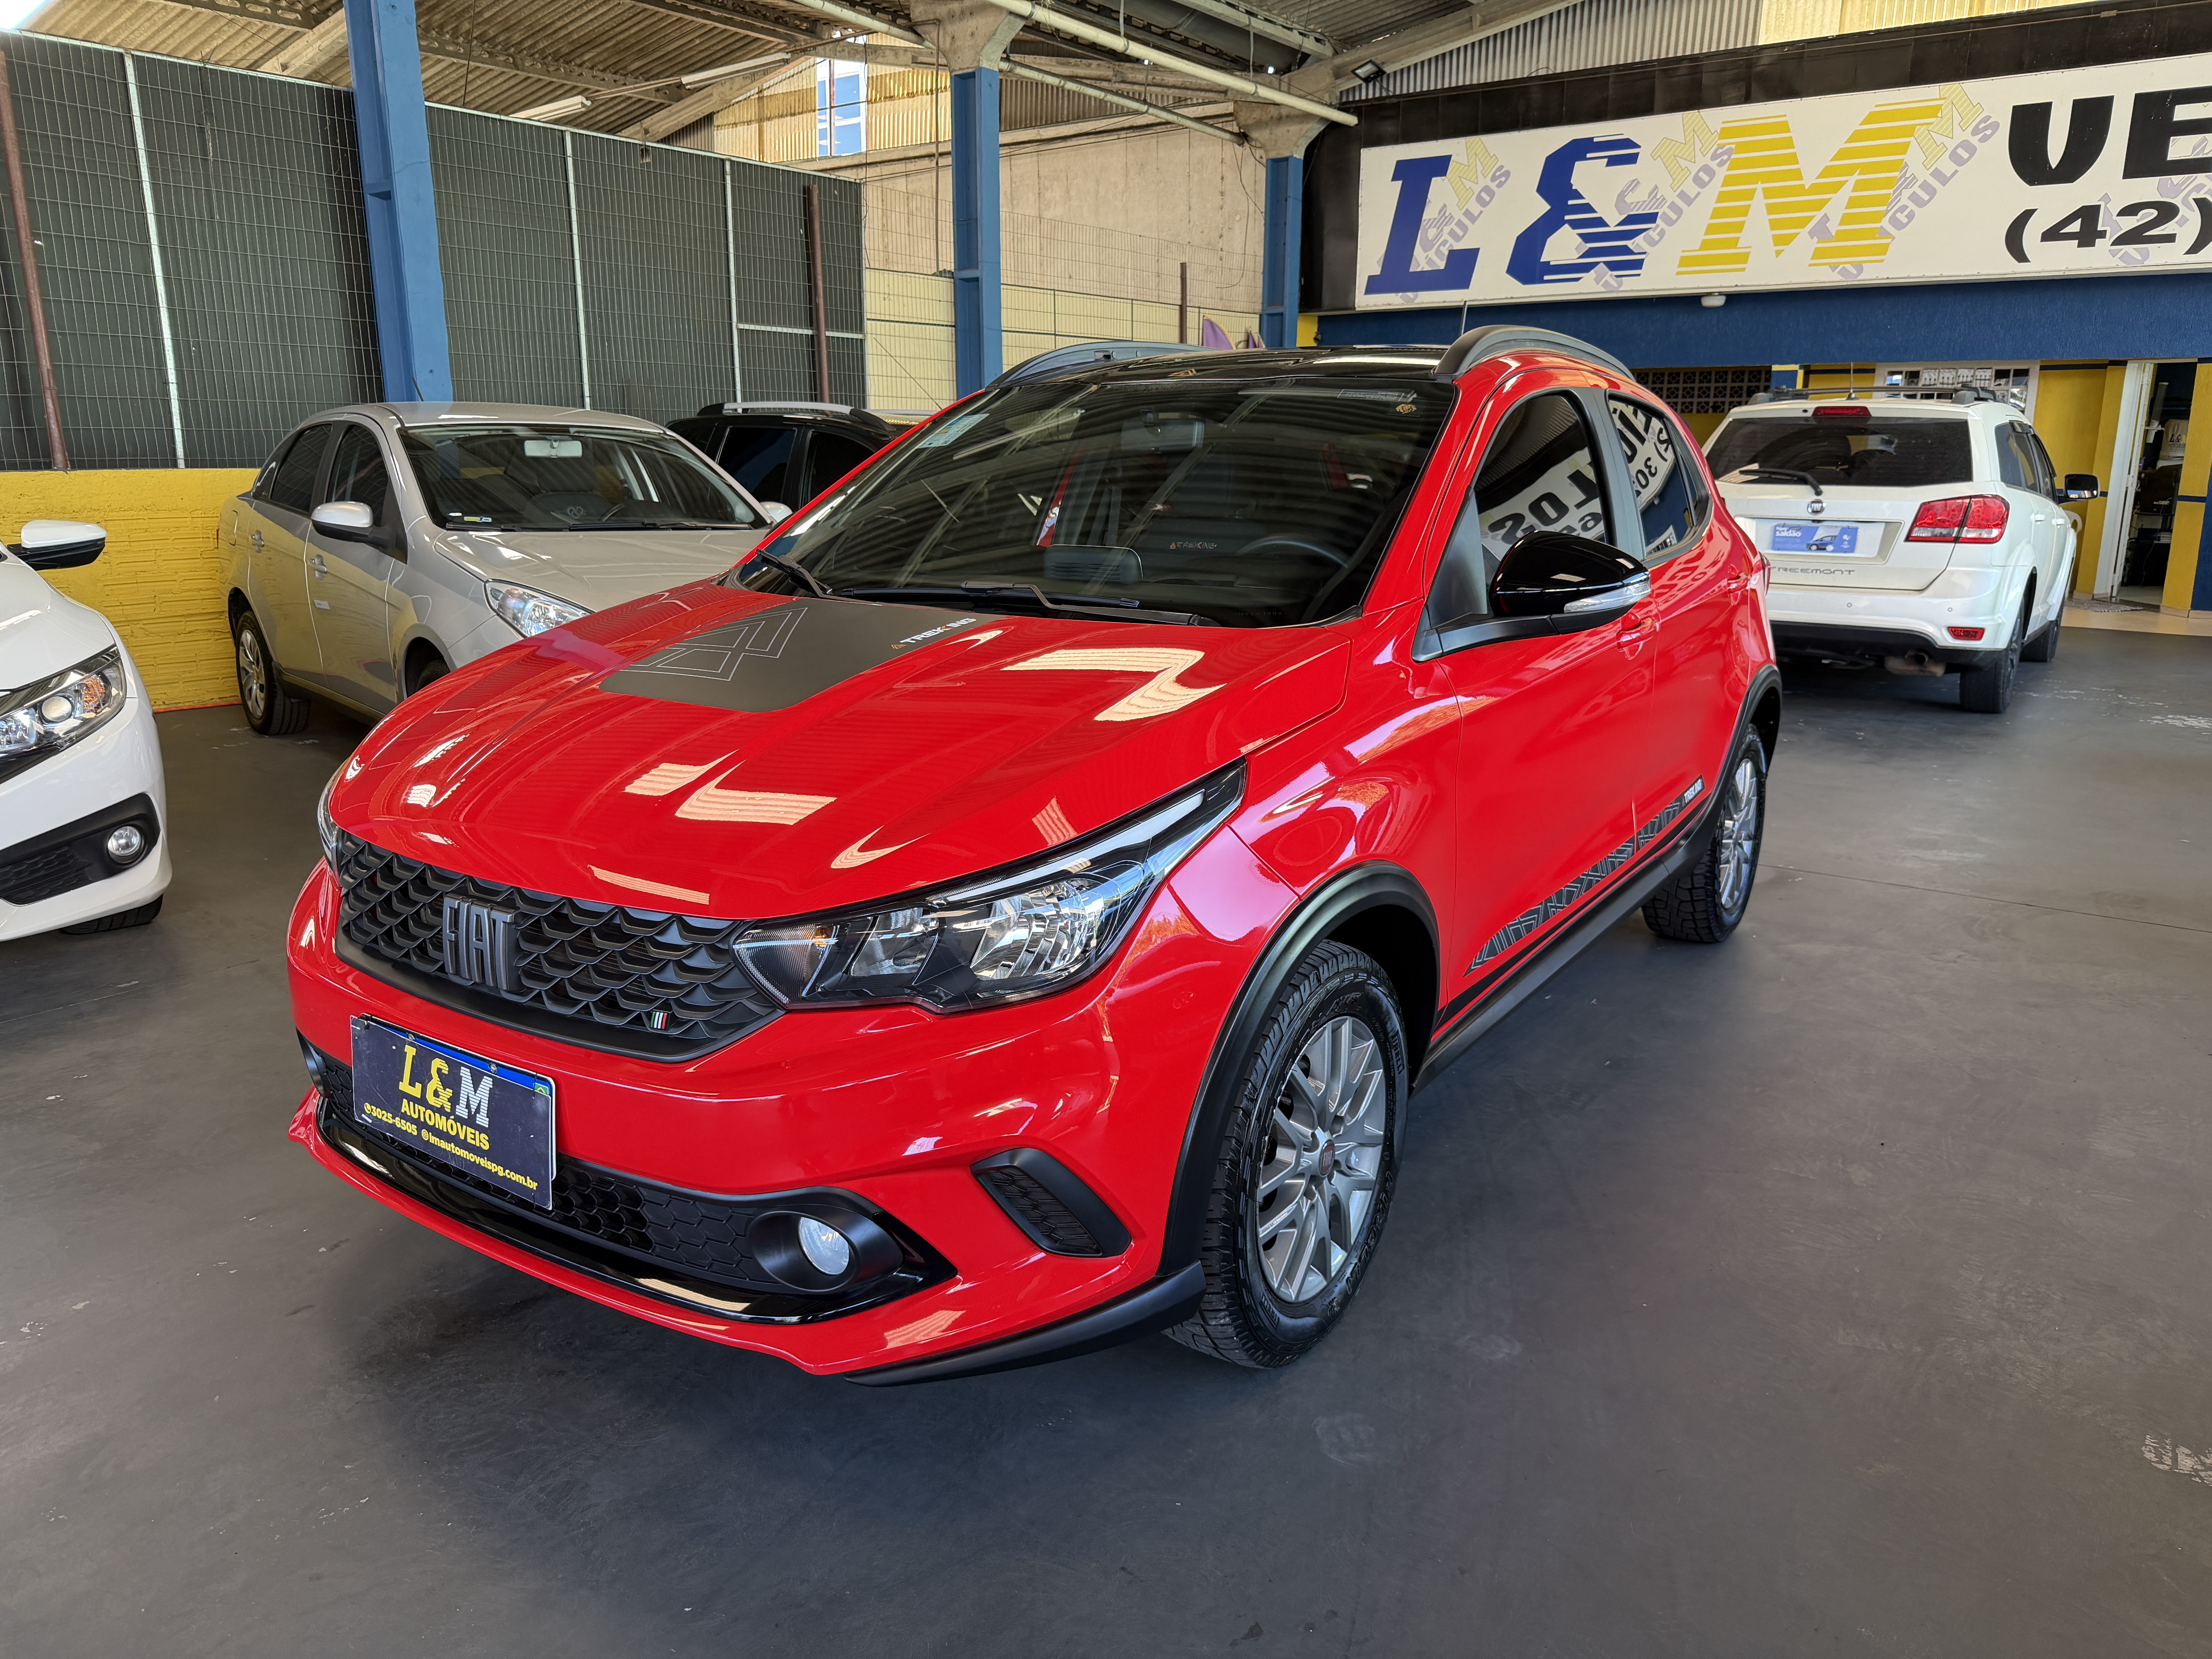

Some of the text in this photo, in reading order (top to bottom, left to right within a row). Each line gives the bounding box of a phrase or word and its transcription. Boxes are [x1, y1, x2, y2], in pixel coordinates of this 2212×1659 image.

[1364, 97, 1947, 295] L&M
[2005, 197, 2212, 263] (42)
[442, 895, 517, 991] FIAT
[399, 1044, 493, 1127] L&M
[401, 1098, 490, 1150] AUTOMÓVEIS
[371, 1105, 538, 1190] 3025-6505 lmautomoveispg.com.br
